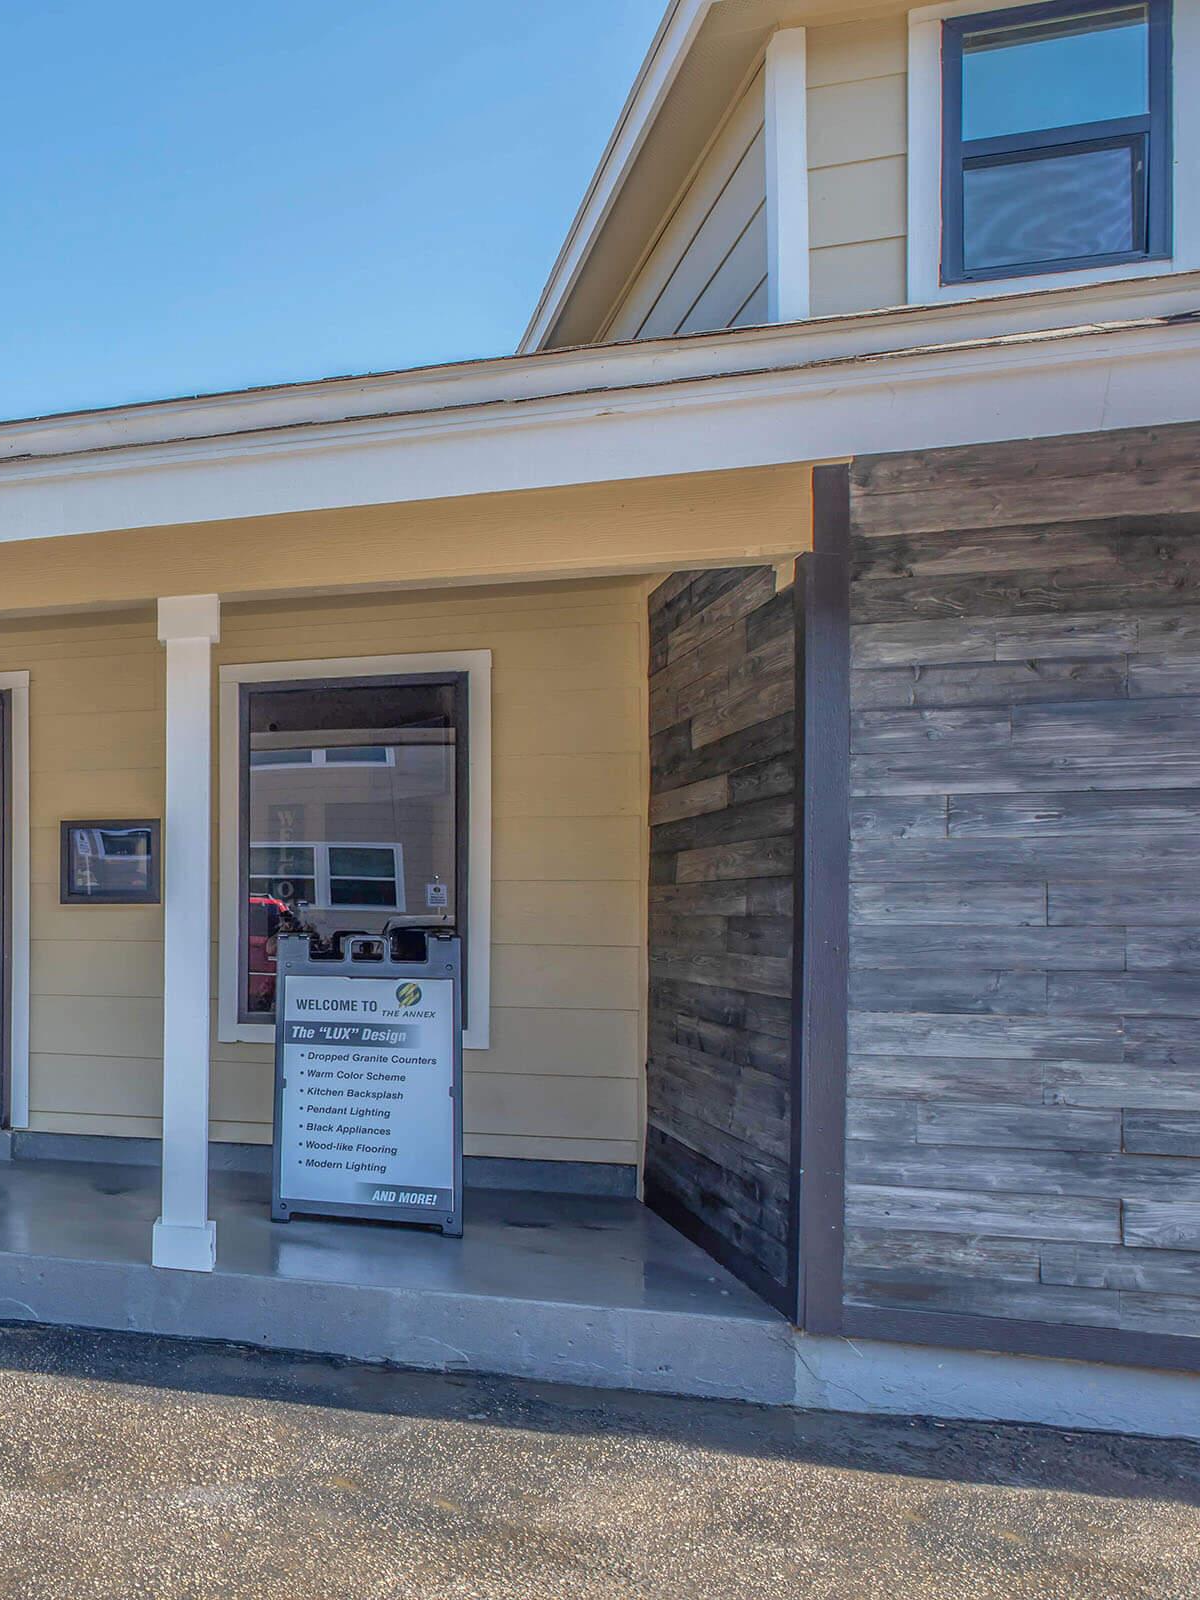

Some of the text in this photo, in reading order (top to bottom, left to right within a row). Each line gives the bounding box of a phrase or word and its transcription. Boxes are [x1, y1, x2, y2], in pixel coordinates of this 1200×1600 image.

[296, 999, 378, 1012] WELCOME TO
[382, 1010, 436, 1018] THE ANNEX
[292, 1026, 315, 1039] The
[362, 1028, 406, 1044] Design
[307, 1052, 437, 1065] Dropped Granite Counters
[307, 1069, 406, 1082] Warm Color Scheme
[307, 1087, 404, 1101] Kitchen Backsplash
[306, 1104, 391, 1119] Pendant Lighting
[306, 1122, 392, 1136] Black Appliances
[305, 1140, 398, 1156] Wood-like Flooring
[305, 1158, 387, 1174] Modern Lighting
[372, 1190, 438, 1206] AND MORE!
